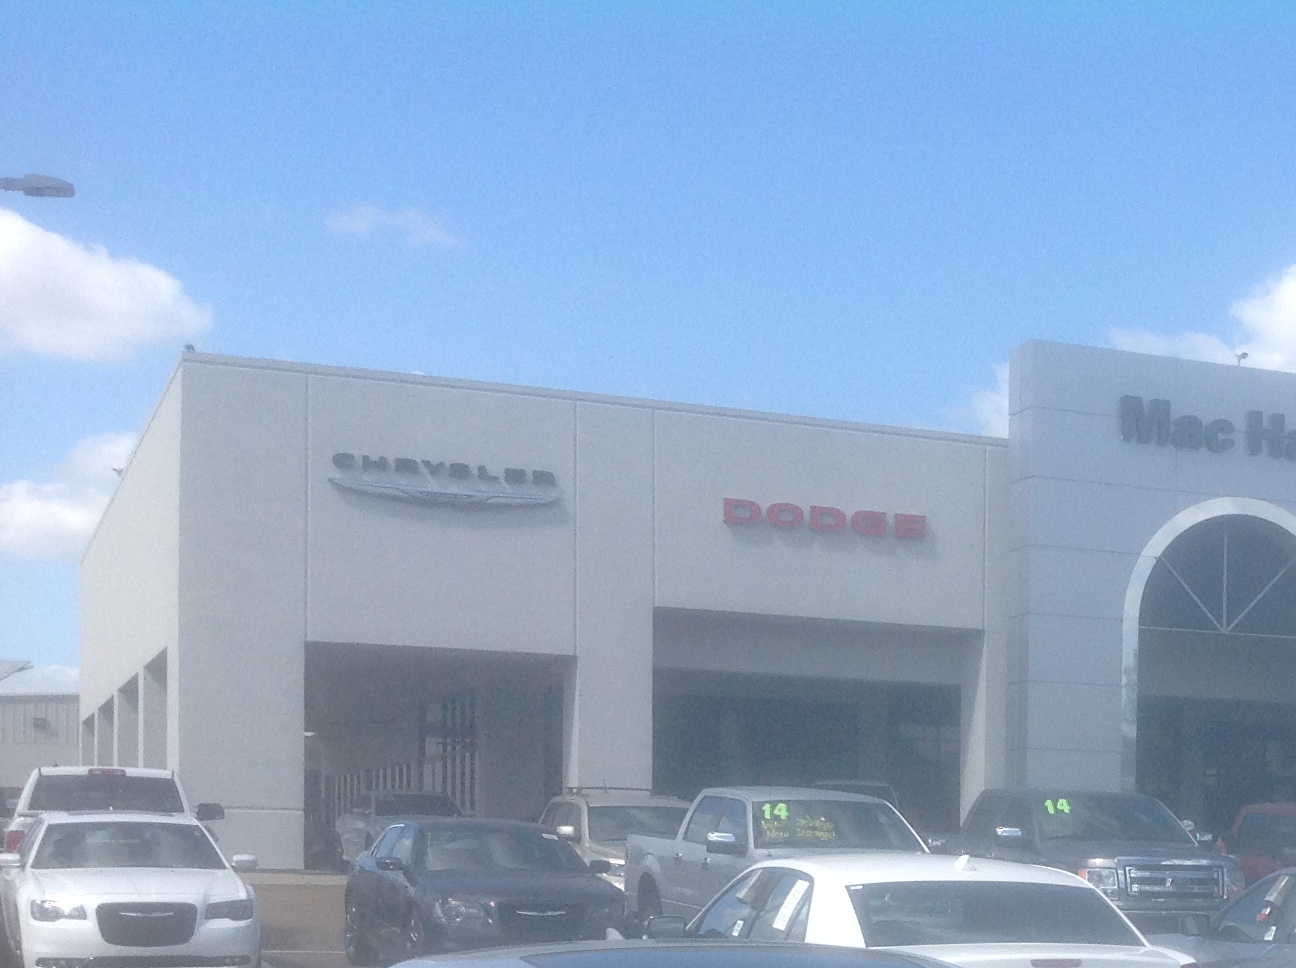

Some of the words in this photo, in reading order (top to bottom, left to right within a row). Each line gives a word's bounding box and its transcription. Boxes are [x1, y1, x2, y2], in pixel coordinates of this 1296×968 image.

[1119, 394, 1235, 453] Mac
[723, 497, 927, 540] DODGE
[762, 803, 789, 820] 14
[1044, 798, 1071, 814] 14
